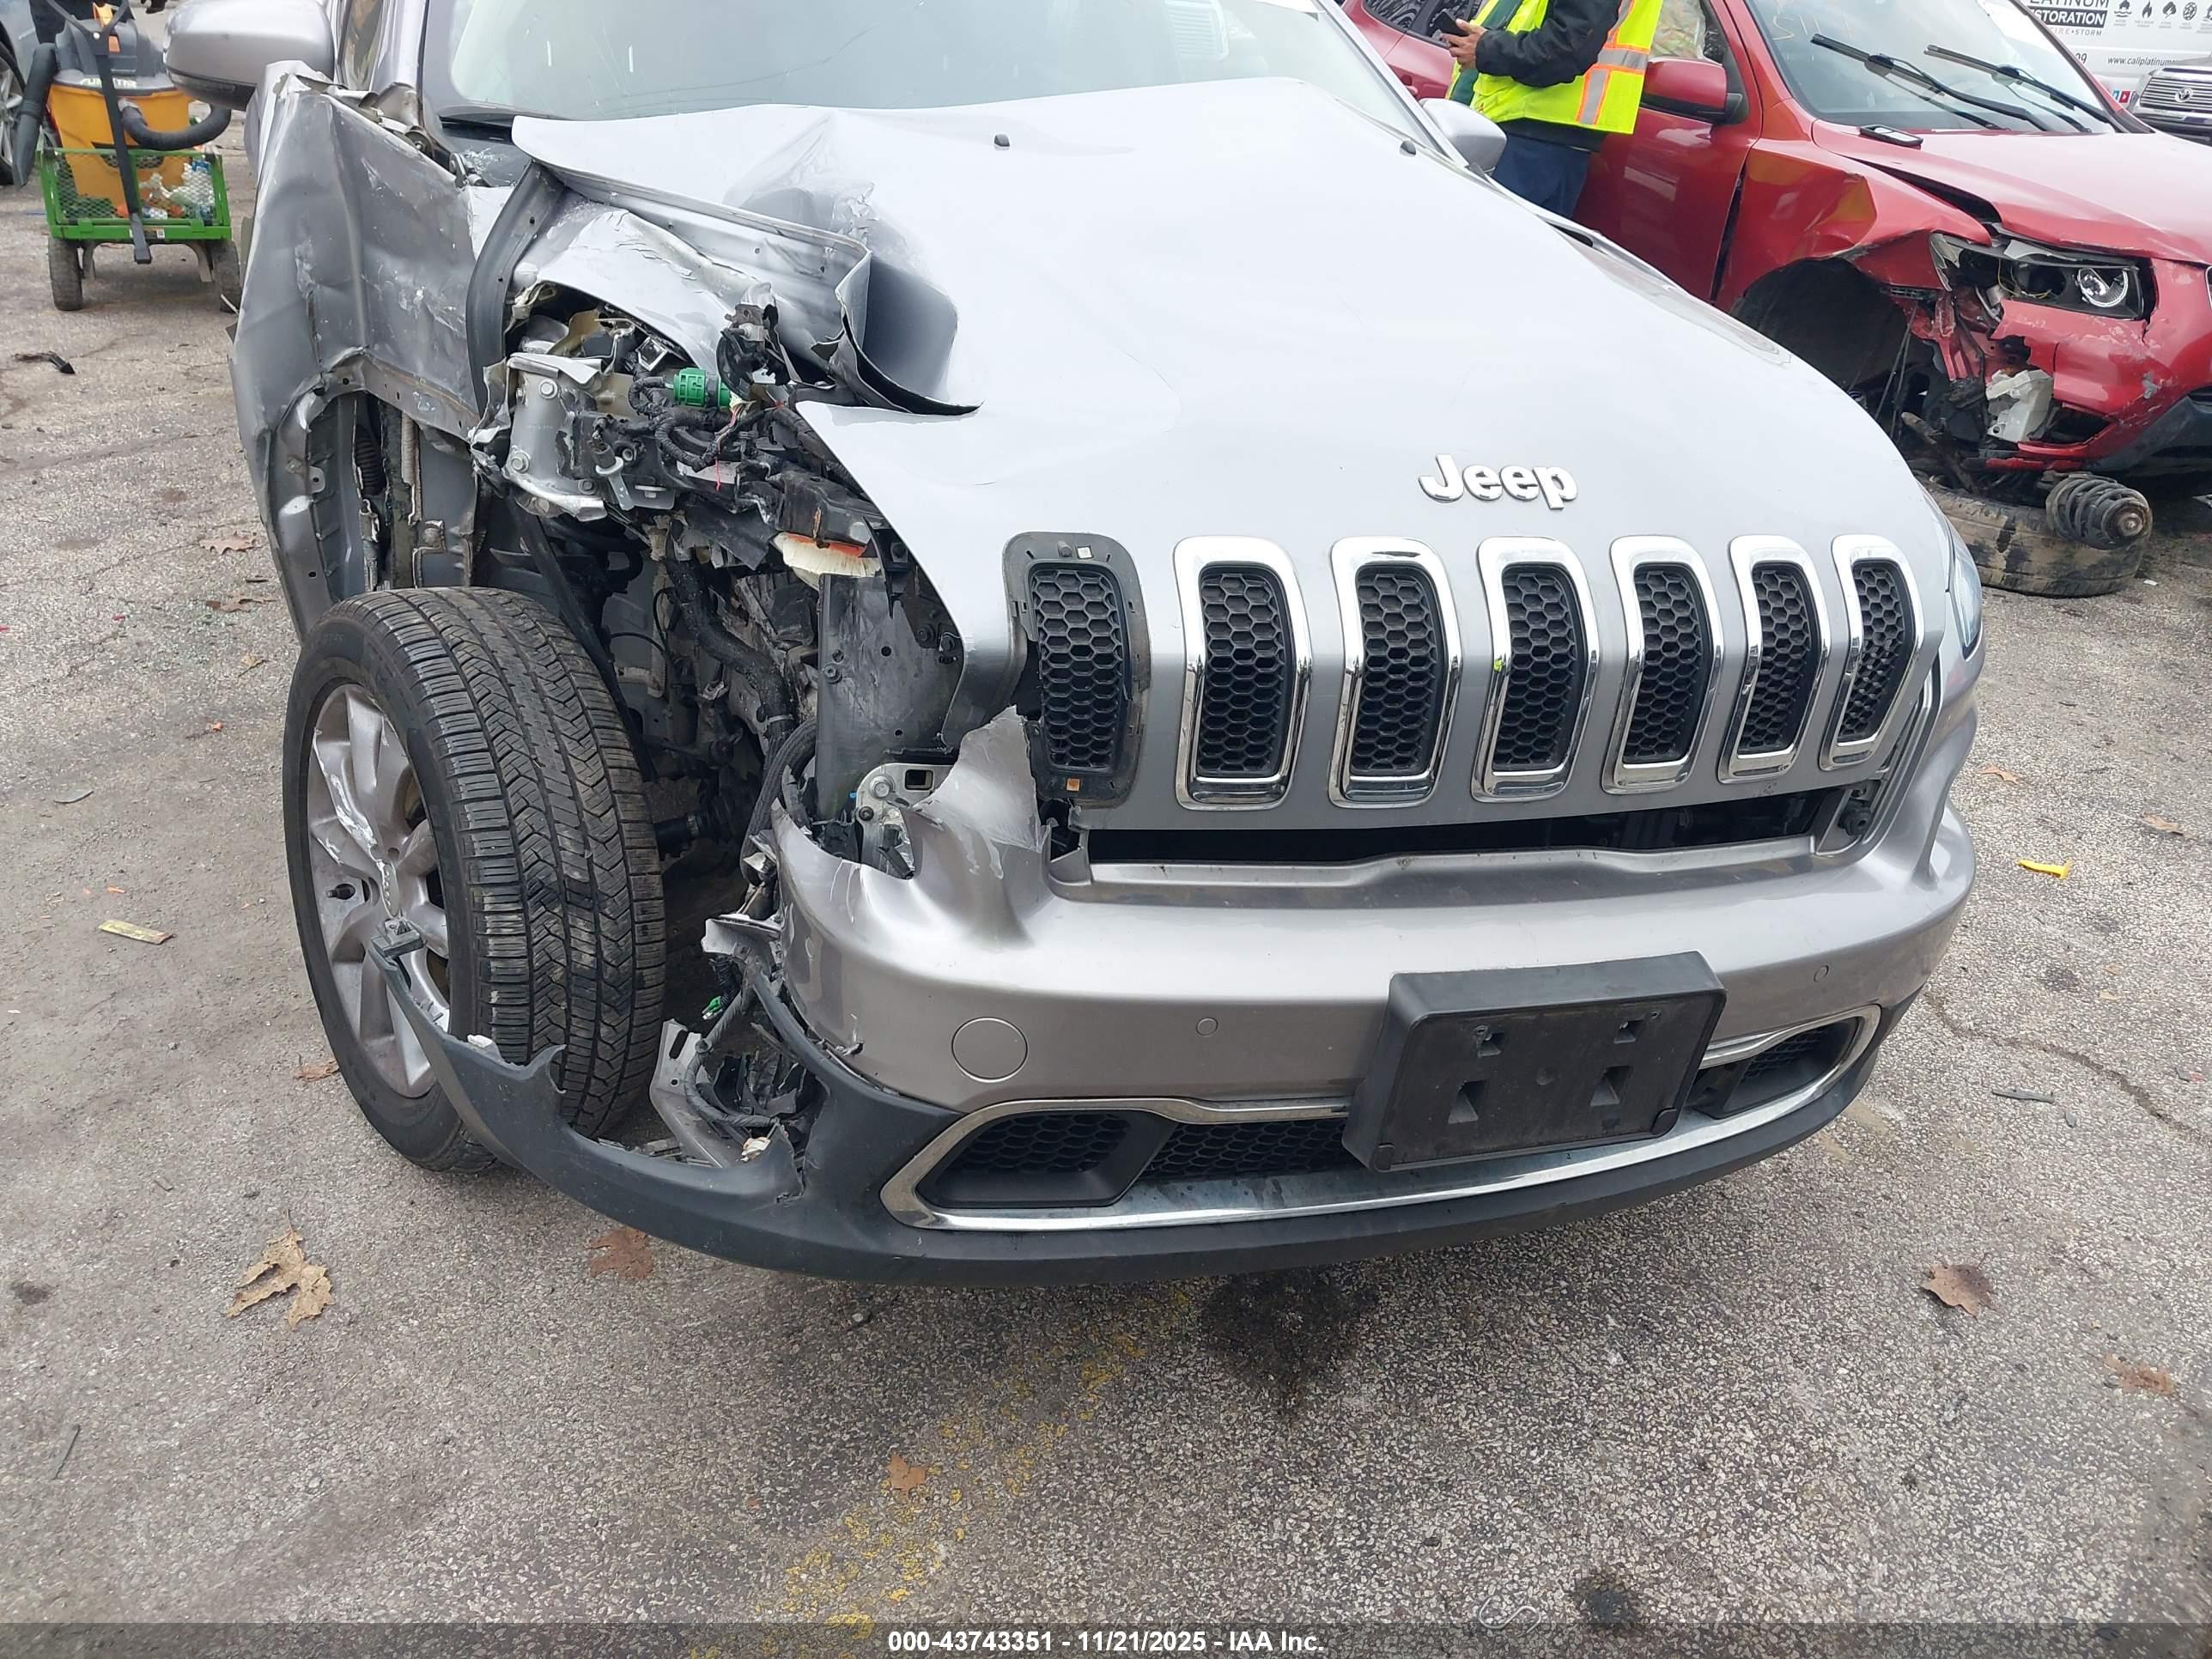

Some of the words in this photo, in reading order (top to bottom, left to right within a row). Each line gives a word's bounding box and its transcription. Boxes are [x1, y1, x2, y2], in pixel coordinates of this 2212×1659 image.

[2033, 9, 2106, 26] STORATION
[2107, 56, 2176, 67] www.callplatinum
[1418, 453, 1578, 511] Jeep
